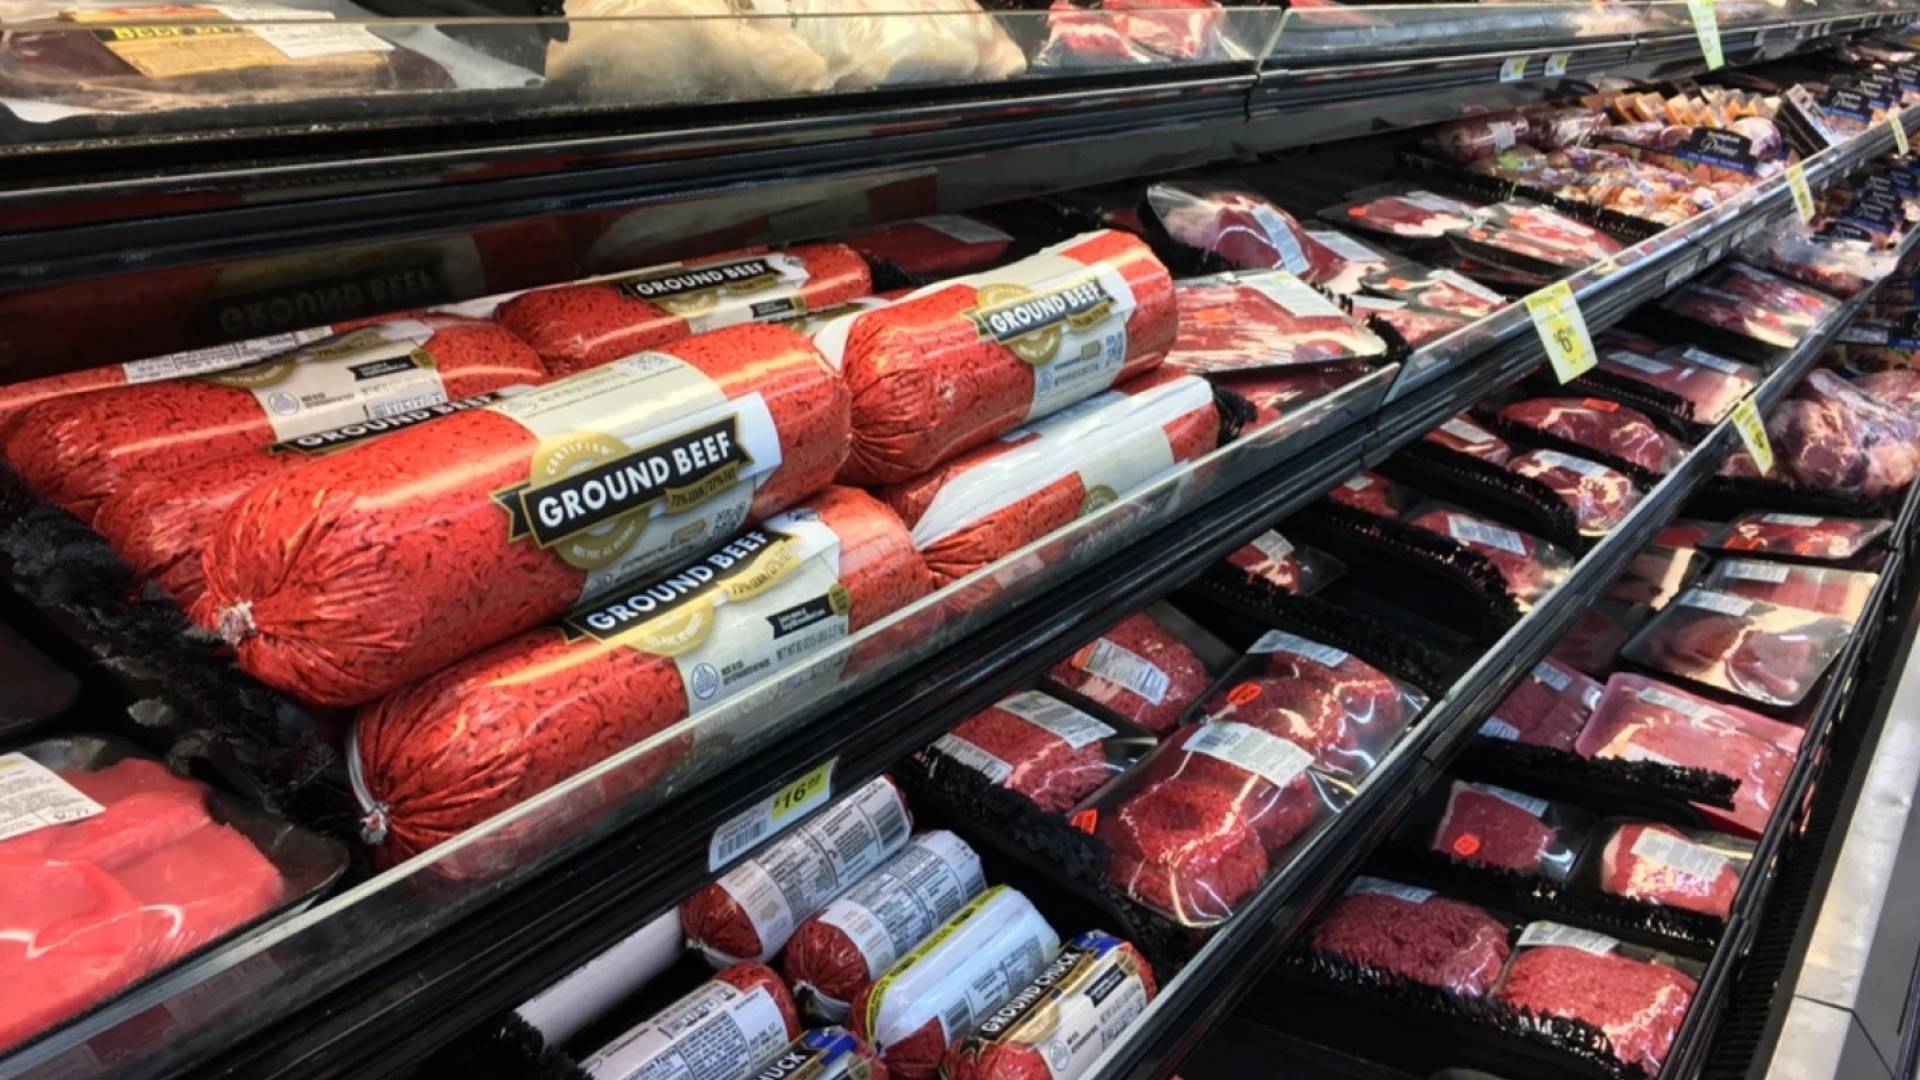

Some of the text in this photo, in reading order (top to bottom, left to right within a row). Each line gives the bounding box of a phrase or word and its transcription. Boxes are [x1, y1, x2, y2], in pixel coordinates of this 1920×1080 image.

[637, 269, 724, 295] GROUND
[721, 261, 765, 279] BEEF
[990, 294, 1066, 333] GROUND
[1063, 281, 1100, 308] BEEF
[297, 406, 431, 447] GROUND
[538, 430, 730, 528] GROUND BEEF
[586, 565, 714, 630] GROUND
[707, 529, 767, 569] BEEF
[981, 985, 1041, 1034] GROUND
[1034, 951, 1082, 986] CHUCK
